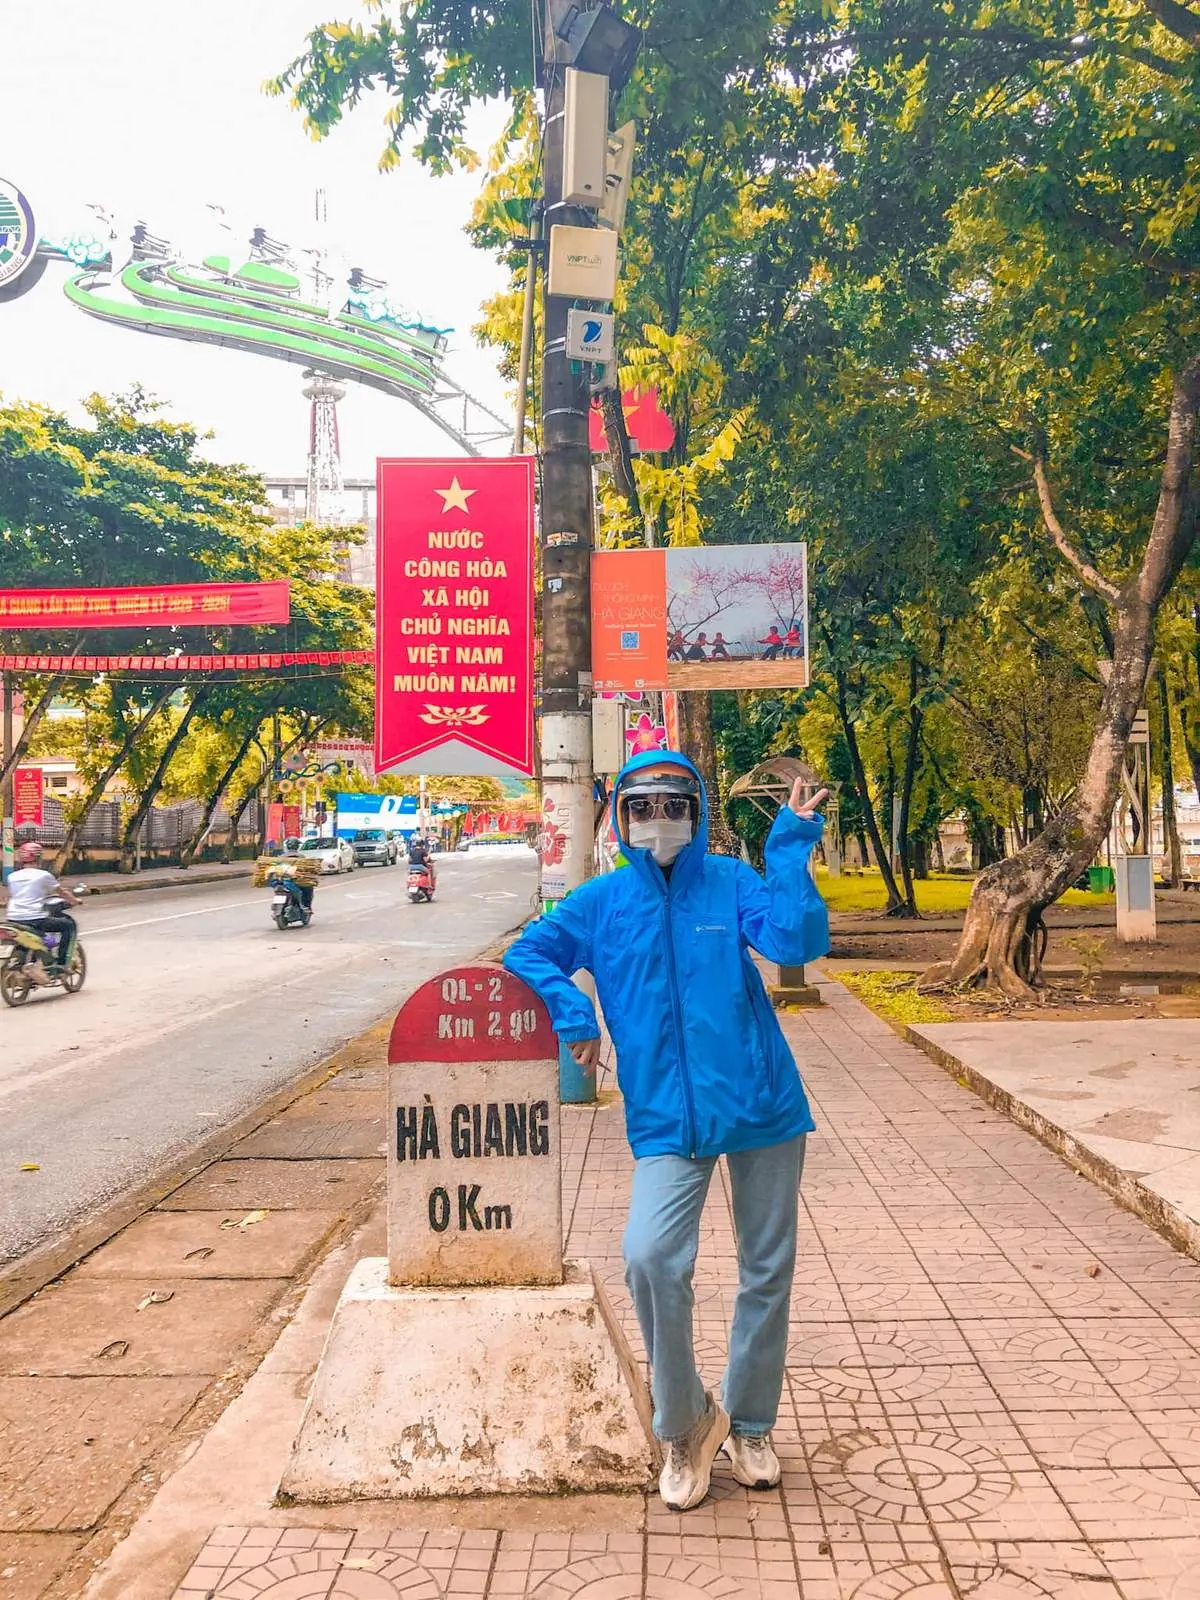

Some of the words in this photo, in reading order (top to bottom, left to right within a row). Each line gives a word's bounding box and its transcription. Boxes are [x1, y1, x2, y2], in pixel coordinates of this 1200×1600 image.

[579, 344, 601, 354] VNPT
[429, 528, 483, 549] NƯỚC
[405, 556, 459, 577] CÔNG
[467, 556, 507, 577] HÒA
[422, 587, 448, 606] XÃ
[456, 587, 489, 610] HỘI
[401, 612, 441, 635] CHỦ
[448, 615, 510, 635] NGHĨA
[408, 644, 449, 667] VIỆT
[456, 647, 502, 664] NAM
[394, 671, 454, 692] MUÔN
[462, 672, 515, 692] NĂM!
[438, 1014, 475, 1039] Km
[397, 1094, 440, 1163] HÀ
[451, 1100, 550, 1159] GIANG
[458, 1184, 512, 1231] Km
